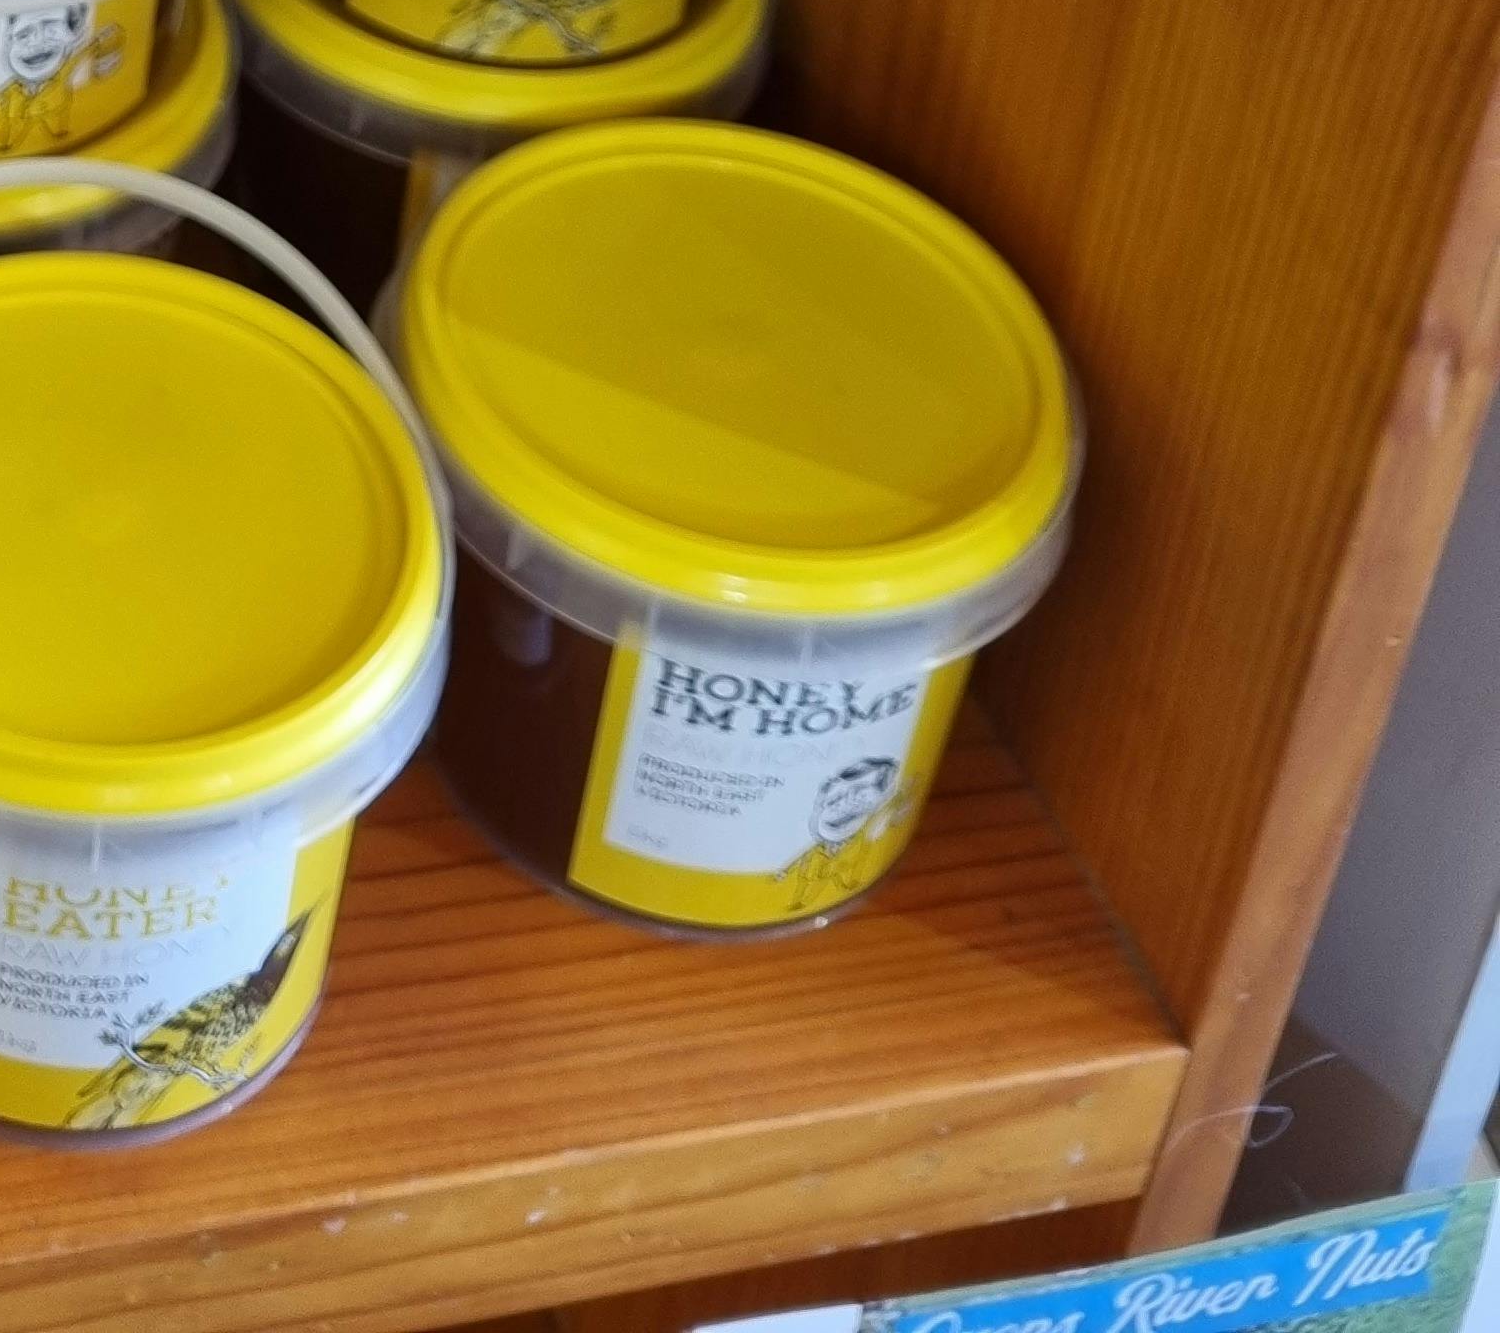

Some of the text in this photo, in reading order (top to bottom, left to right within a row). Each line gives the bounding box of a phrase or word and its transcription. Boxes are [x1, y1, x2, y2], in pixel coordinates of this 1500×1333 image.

[658, 656, 863, 708] HONEY
[652, 682, 919, 736] I'M HOME
[3, 895, 217, 941] EATER
[1291, 1227, 1439, 1309] Nuts
